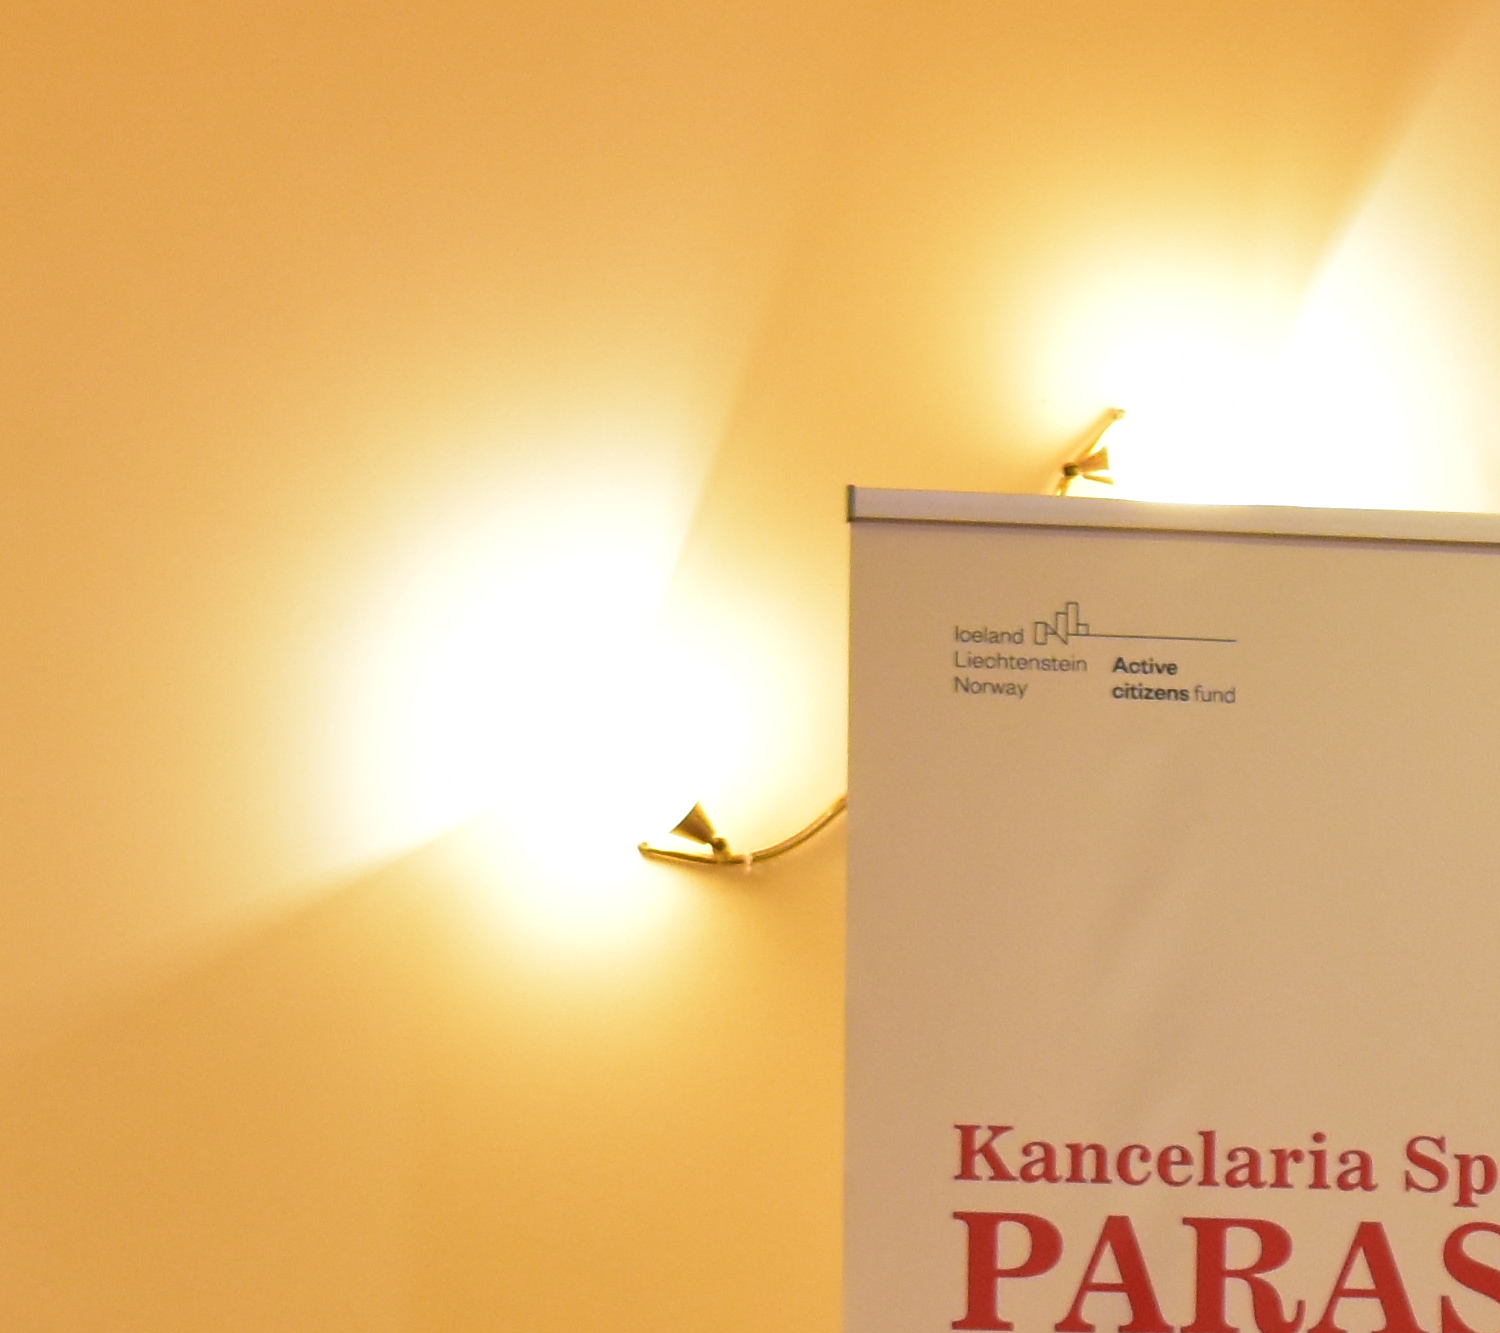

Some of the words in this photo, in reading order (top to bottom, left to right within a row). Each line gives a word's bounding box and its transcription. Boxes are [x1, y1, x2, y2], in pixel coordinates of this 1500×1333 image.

[955, 625, 1023, 644] Iceland
[955, 651, 1088, 672] Liechtenstein
[1112, 656, 1178, 676] Active
[954, 676, 1028, 699] Norway
[1112, 682, 1190, 702] citizens
[1194, 685, 1236, 703] fund
[951, 1122, 1379, 1193] Kancelaria
